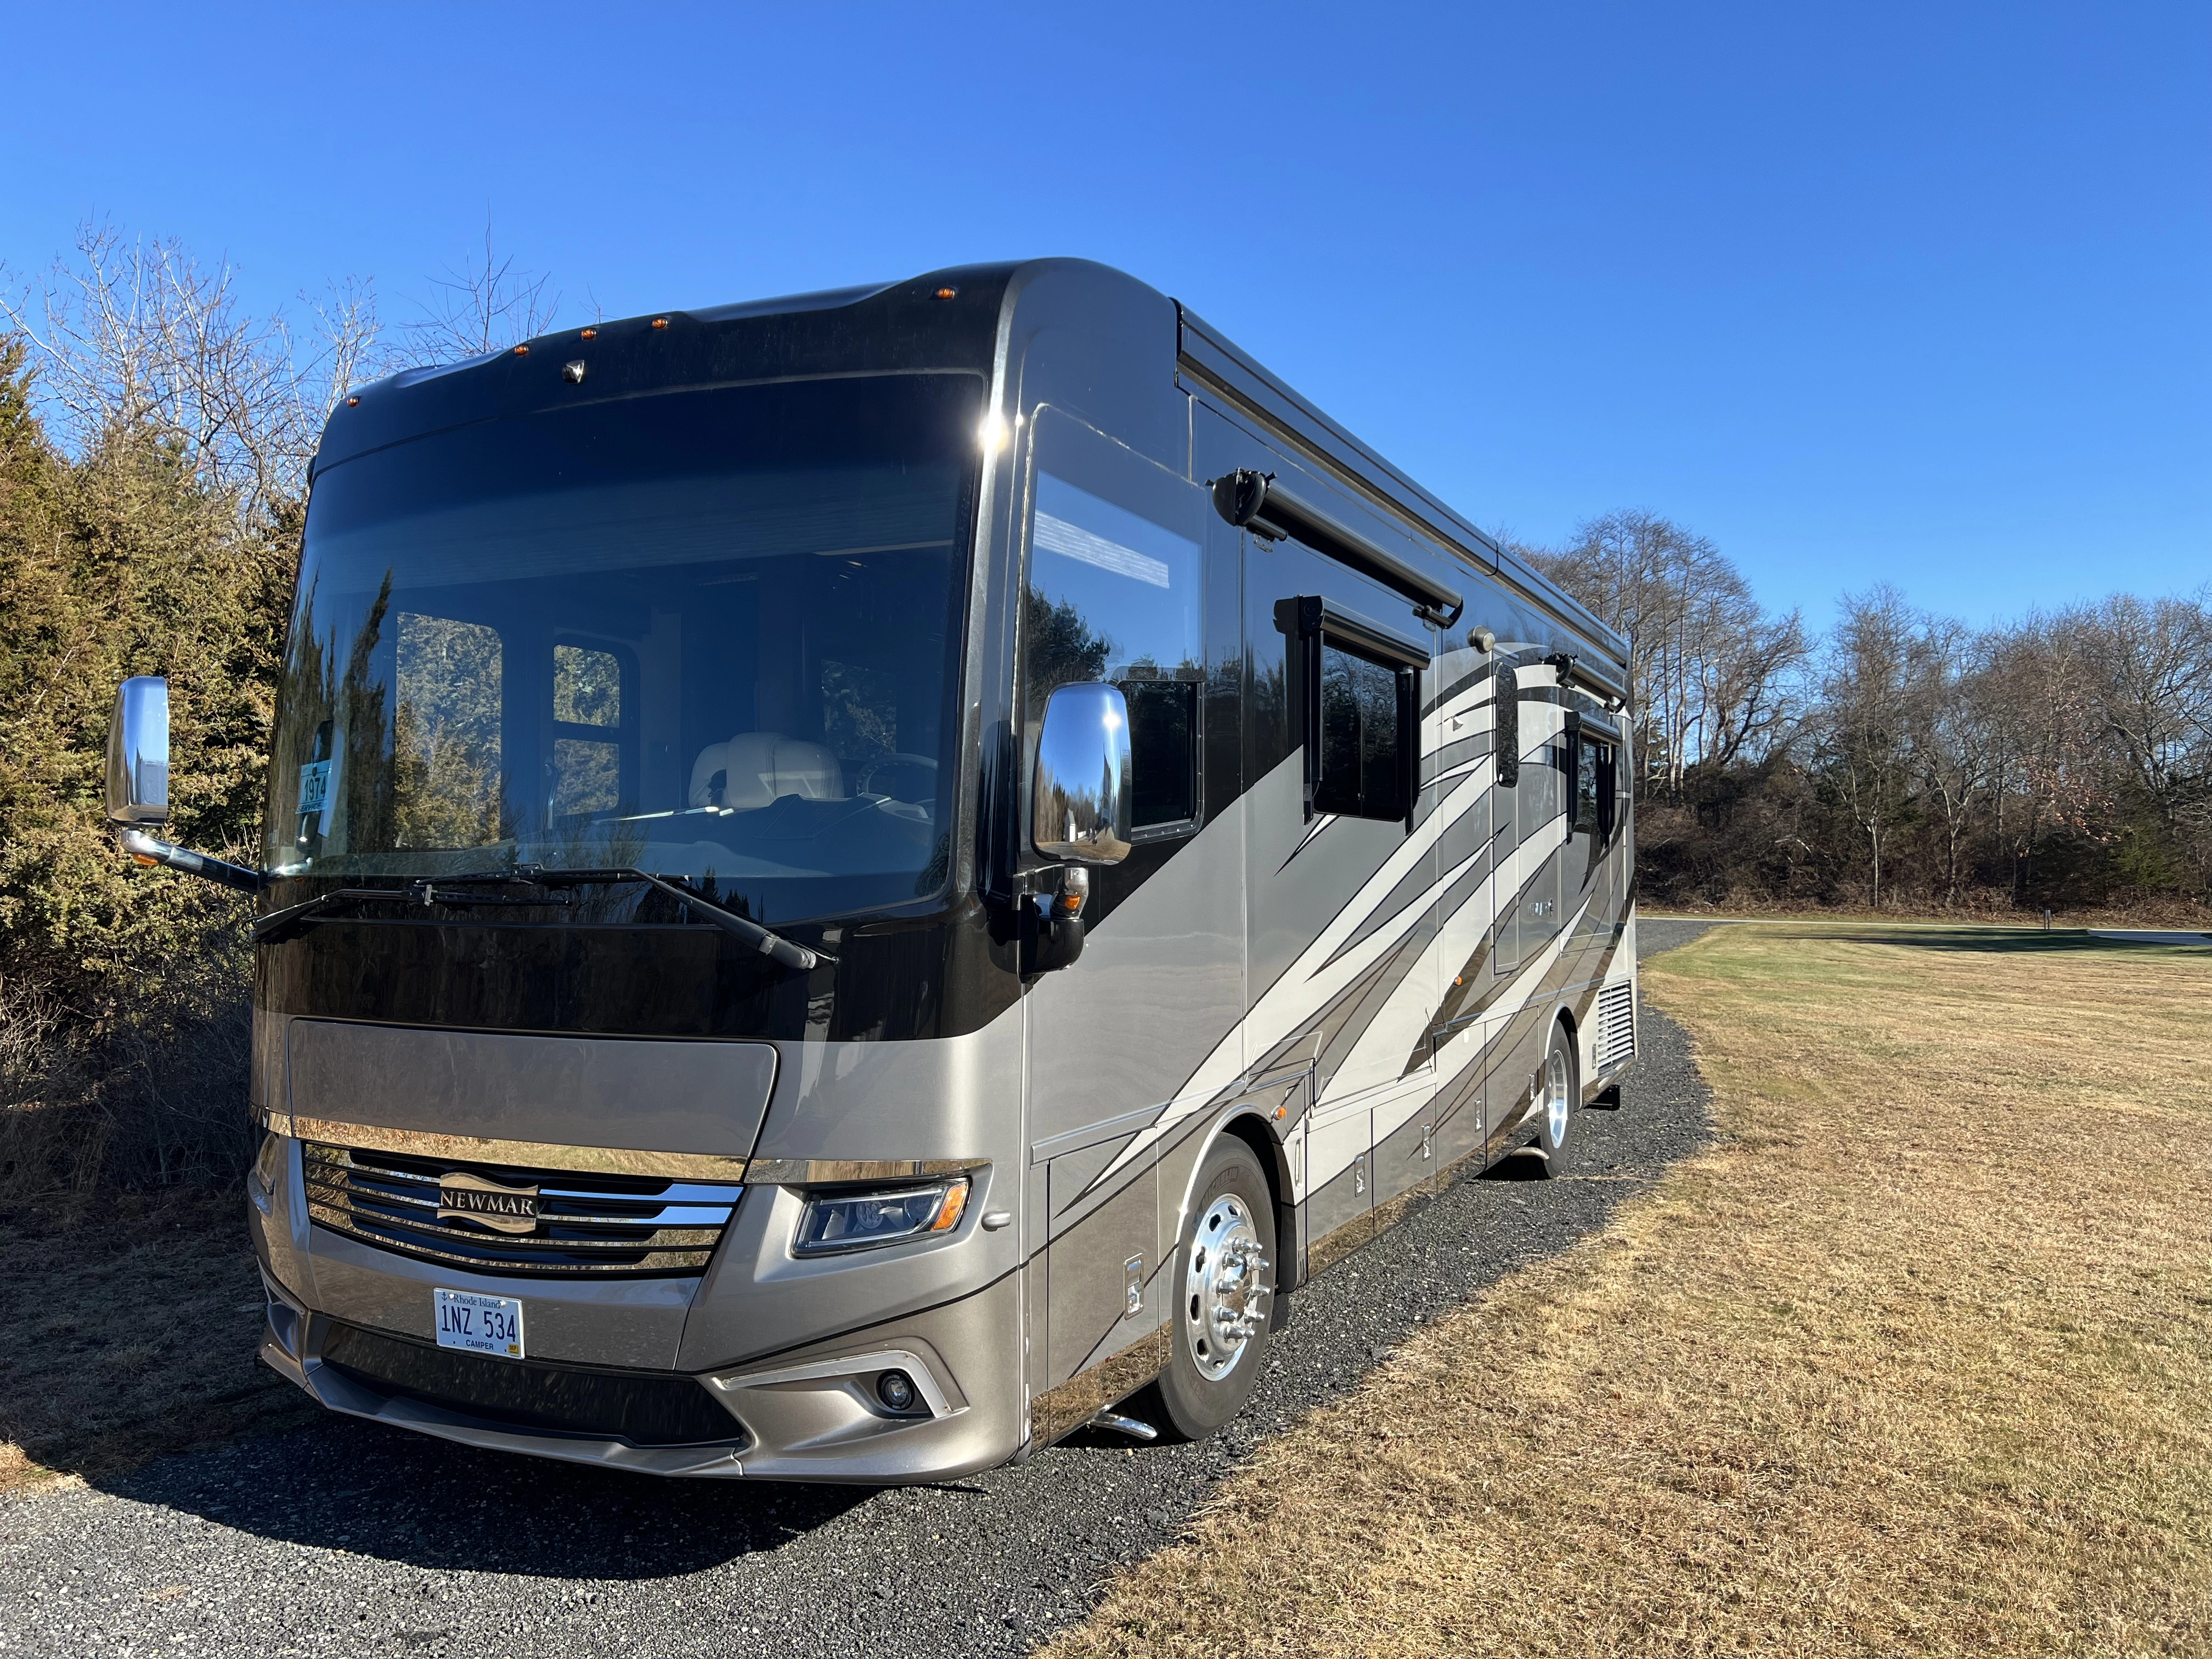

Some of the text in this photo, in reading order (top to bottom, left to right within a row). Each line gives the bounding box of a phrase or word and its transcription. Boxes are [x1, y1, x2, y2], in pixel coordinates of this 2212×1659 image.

[304, 775, 326, 801] 1974
[297, 802, 322, 812] SERVICE
[1200, 1167, 1239, 1212] MICHELIN
[440, 1190, 535, 1216] NEWMAR
[454, 1294, 501, 1309] Rhode Island
[442, 1305, 516, 1342] 1NZ 534
[466, 1339, 494, 1351] CAMPER
